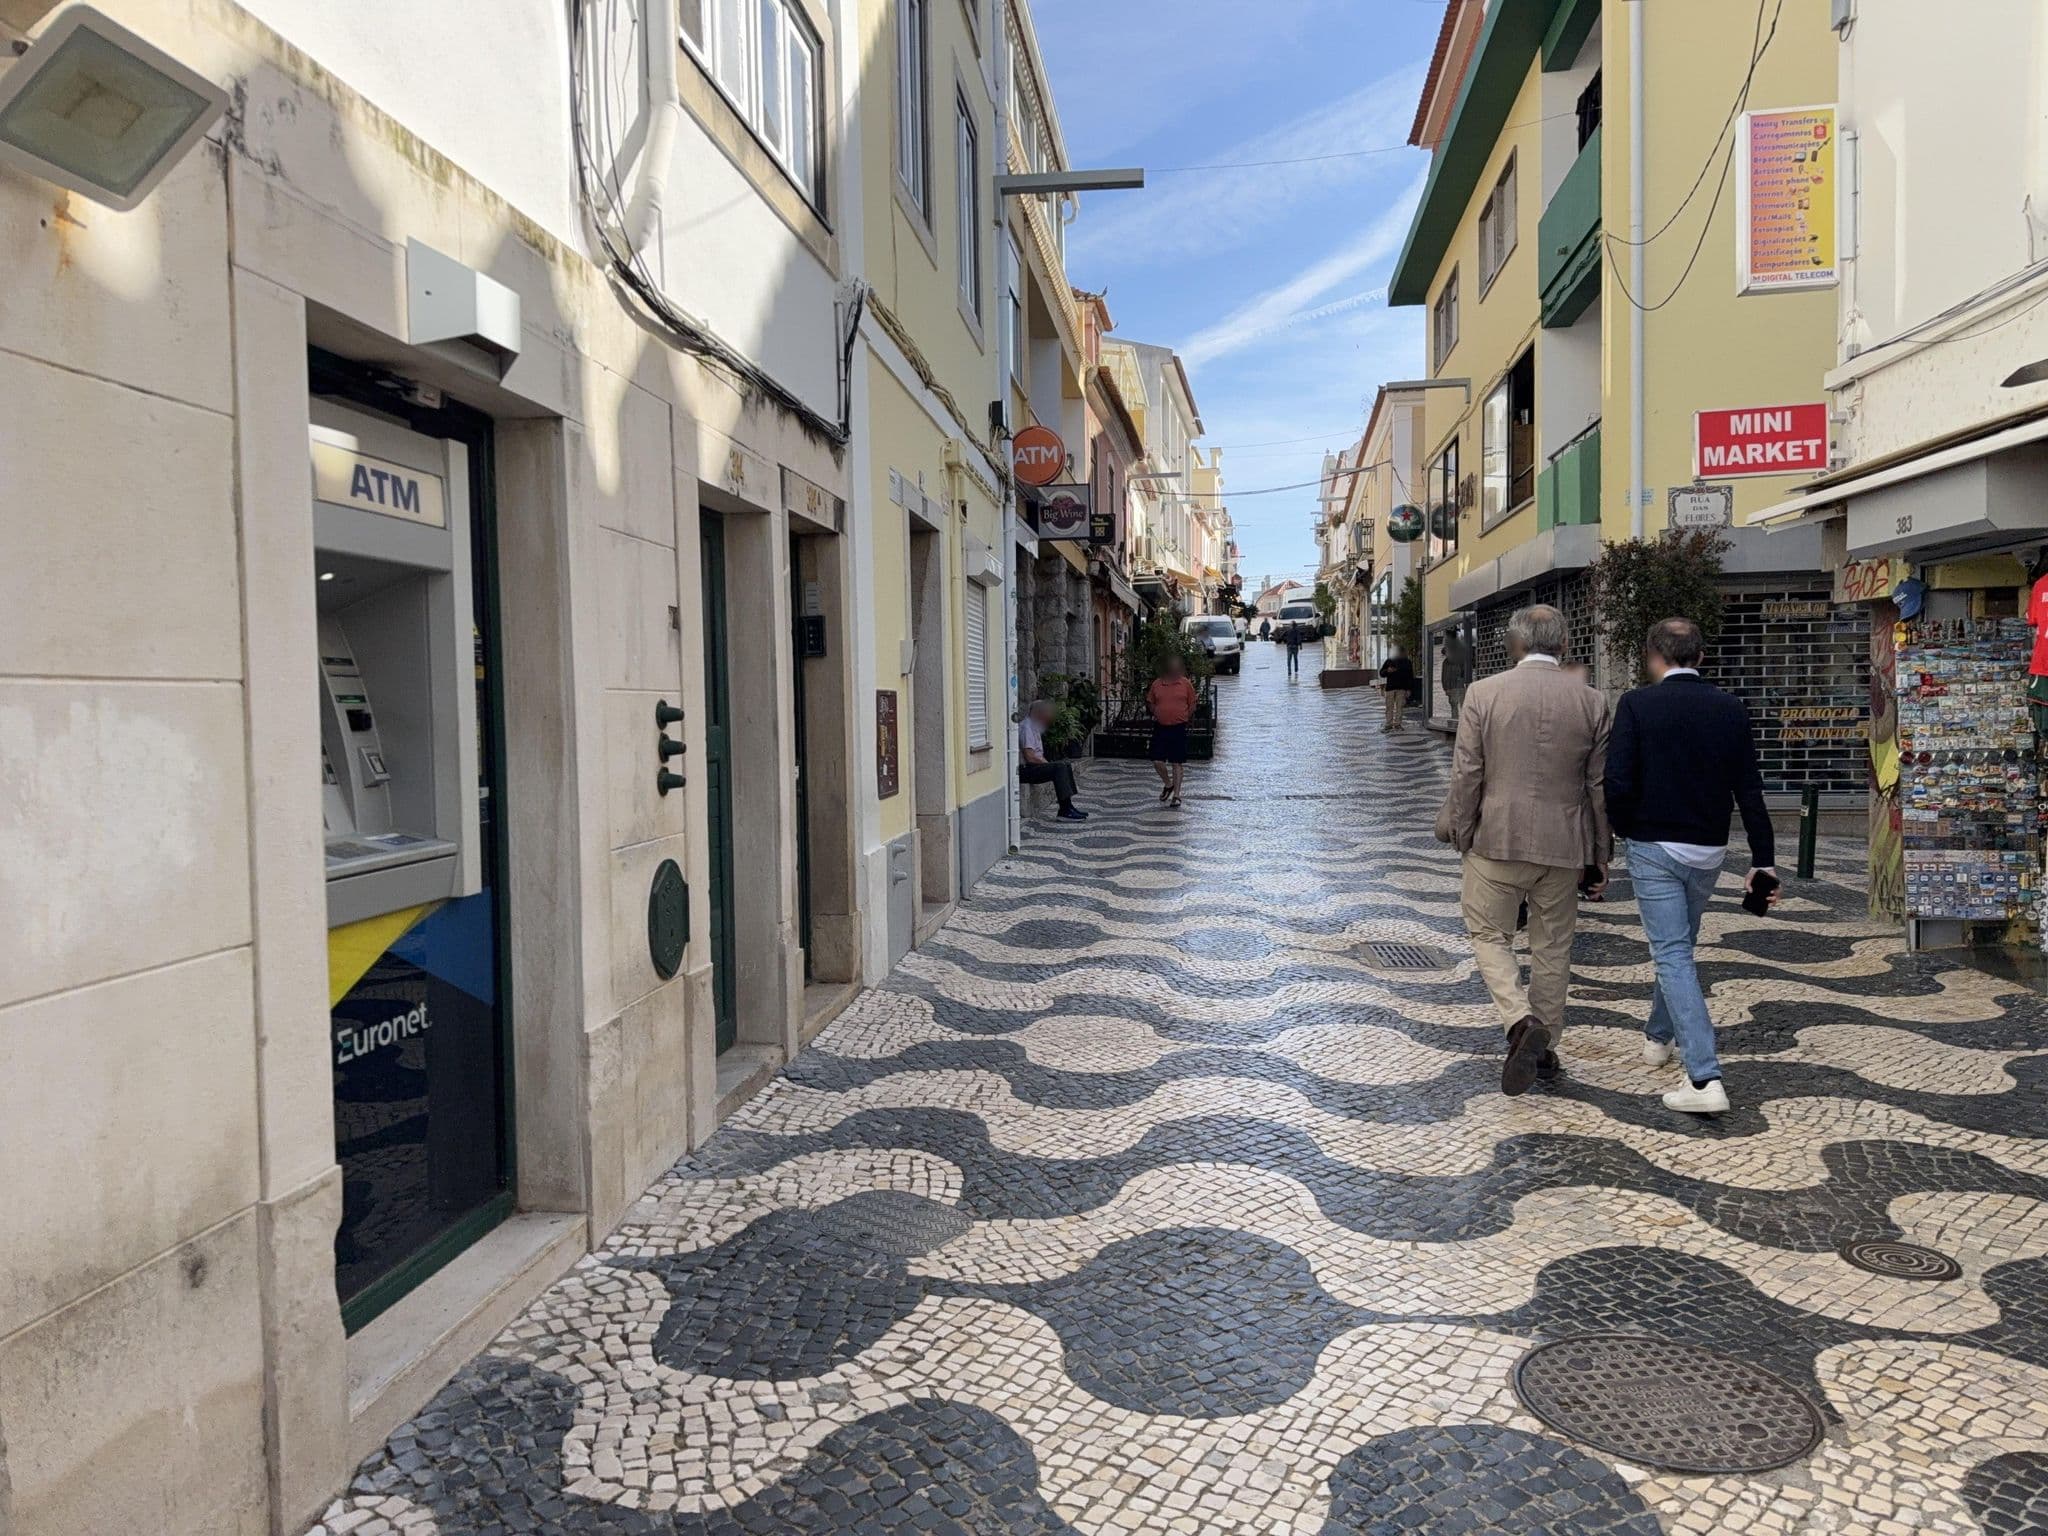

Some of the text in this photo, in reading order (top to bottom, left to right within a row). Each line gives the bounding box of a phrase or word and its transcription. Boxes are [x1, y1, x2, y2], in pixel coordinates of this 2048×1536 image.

[1781, 117, 1818, 126] Transfers
[1753, 130, 1812, 141] Carregamentos
[1754, 259, 1810, 269] Computadores
[1761, 273, 1792, 282] DIGITAL
[1795, 270, 1834, 280] TELECOM
[1730, 411, 1792, 436] MINI
[1014, 445, 1059, 465] ATM
[1703, 439, 1822, 467] MARKET
[350, 463, 420, 514] ATM
[1690, 496, 1711, 504] RUA
[1043, 508, 1058, 520] Big
[1060, 508, 1084, 519] Wine
[1685, 513, 1716, 522] FLORES
[1895, 514, 1913, 536] 383
[337, 1001, 430, 1065] Euronet
